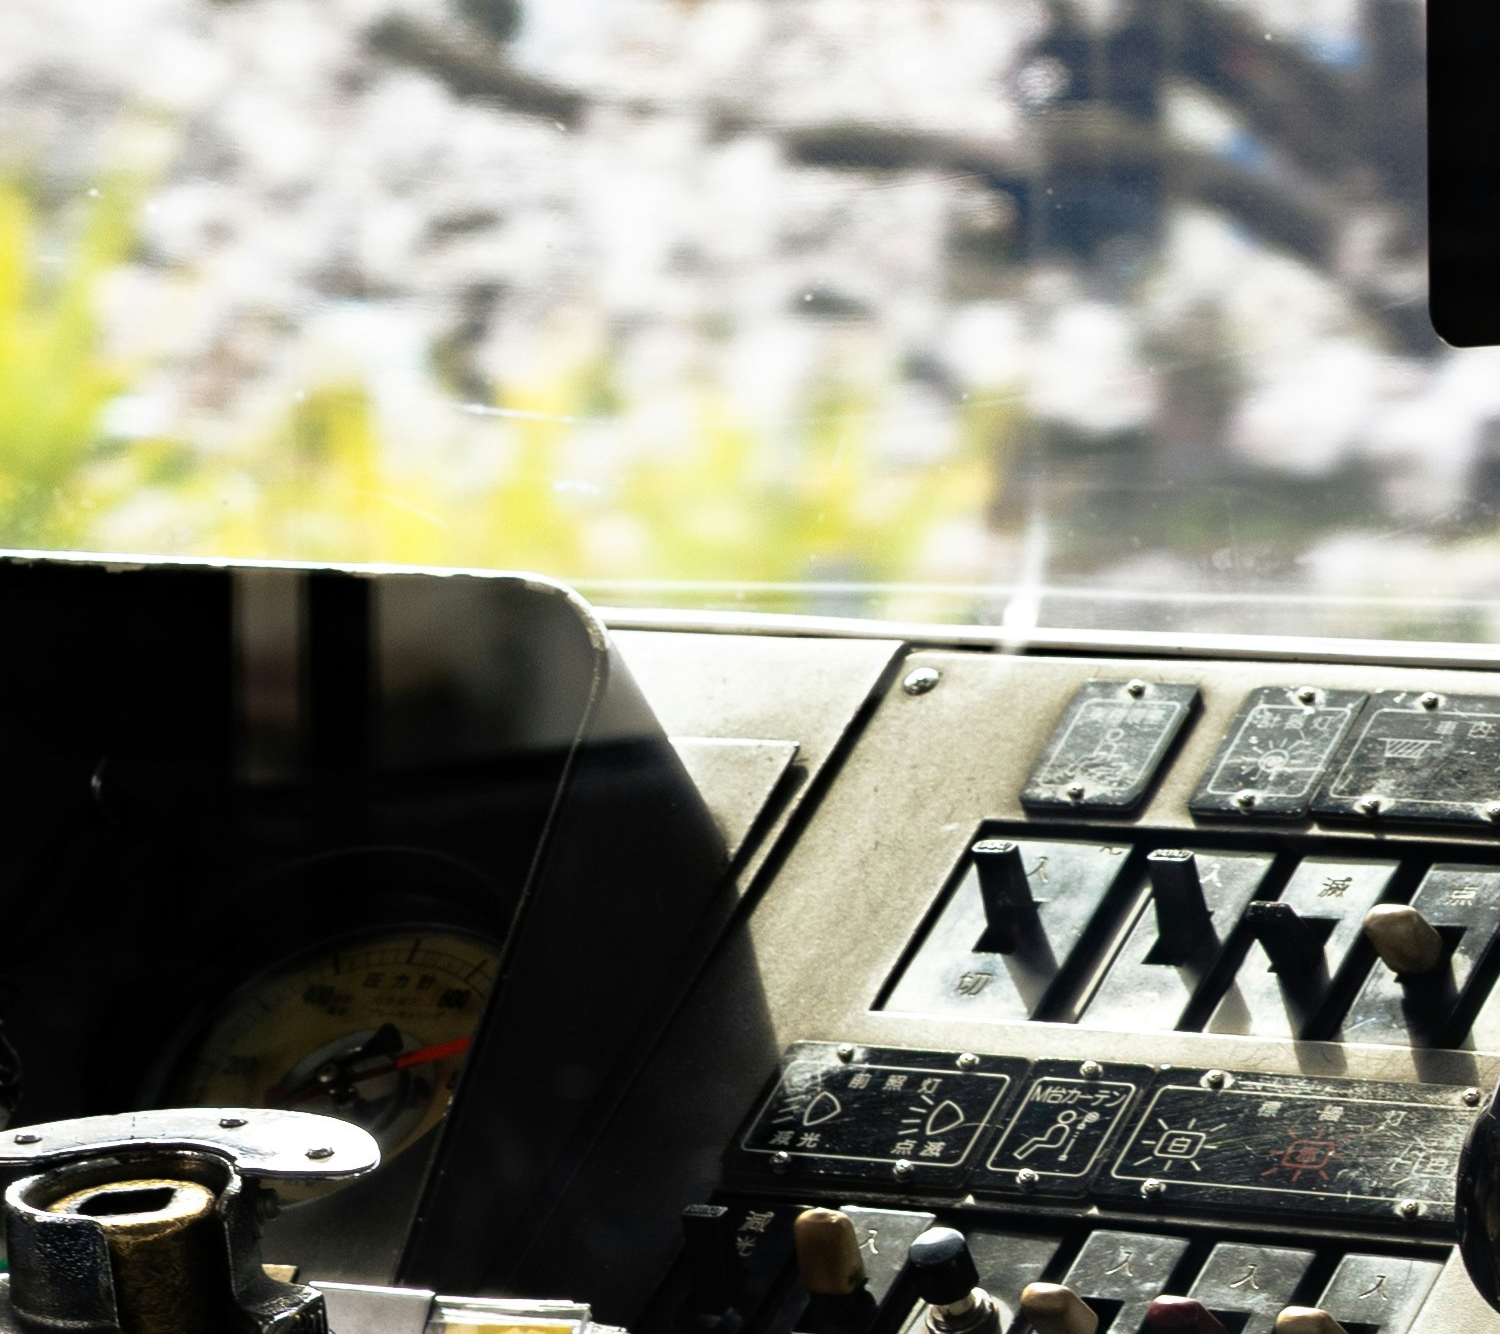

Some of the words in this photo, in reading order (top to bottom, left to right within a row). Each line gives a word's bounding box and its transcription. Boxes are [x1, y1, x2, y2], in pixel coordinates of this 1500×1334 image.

[1444, 883, 1479, 905] 点
[363, 973, 437, 990] 圧力計
[955, 971, 992, 995] 切
[848, 1072, 940, 1095] 前照灯
[1030, 1086, 1127, 1108] M台カーテン
[890, 1139, 945, 1158] 点滅
[1167, 1137, 1190, 1154] 白
[736, 1210, 775, 1258] 減光
[859, 1229, 880, 1255] 入
[1105, 1250, 1134, 1277] 入
[1229, 1263, 1259, 1290] 入
[1358, 1275, 1388, 1302] 入
